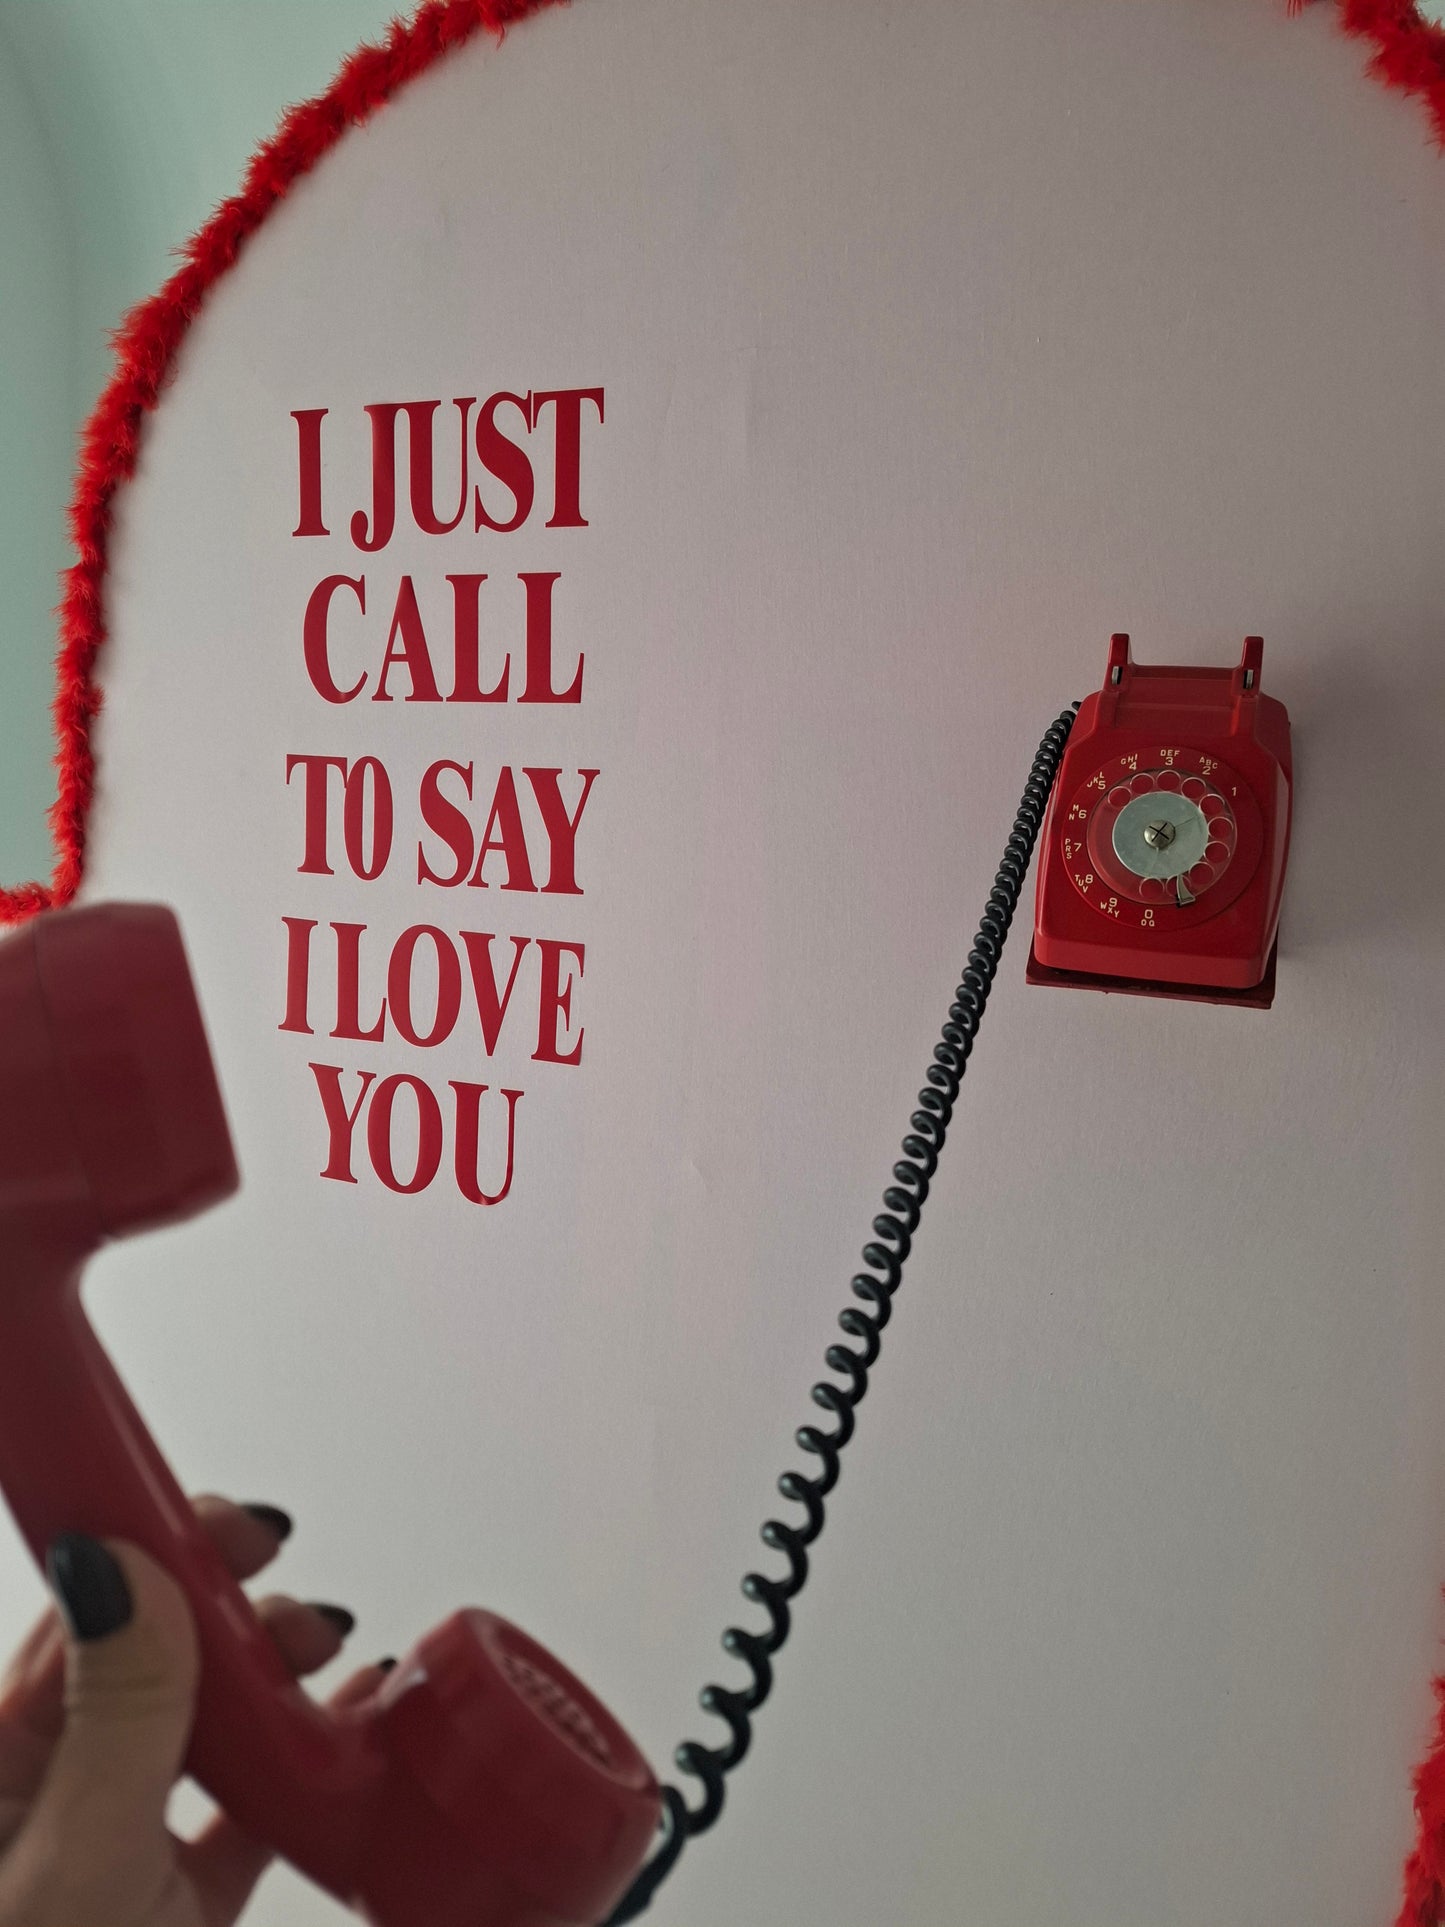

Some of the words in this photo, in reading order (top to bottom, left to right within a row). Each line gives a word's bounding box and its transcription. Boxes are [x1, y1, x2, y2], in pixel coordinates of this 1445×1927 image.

[290, 408, 331, 537] I
[350, 387, 605, 552] JUST
[303, 572, 585, 704] CALL
[1160, 749, 1180, 757] DEF
[1120, 753, 1138, 765] GHI
[1164, 757, 1174, 766] 3
[1199, 756, 1218, 769] ABC
[1129, 762, 1137, 770] 4
[1202, 766, 1211, 775] 2
[1086, 771, 1105, 788] JKL
[1098, 780, 1106, 790] 5
[1231, 786, 1237, 796] 1
[1078, 809, 1087, 819] 6
[286, 754, 394, 882] TO
[417, 759, 601, 895] SAY
[1073, 843, 1082, 852] 7
[1074, 874, 1089, 893] TUV
[1085, 874, 1094, 884] 8
[1109, 897, 1118, 907] 9
[1100, 901, 1120, 918] WXY
[1144, 909, 1153, 919] 0
[278, 916, 319, 1034] I
[329, 921, 585, 1066] LOVE
[308, 1061, 525, 1206] YOU
